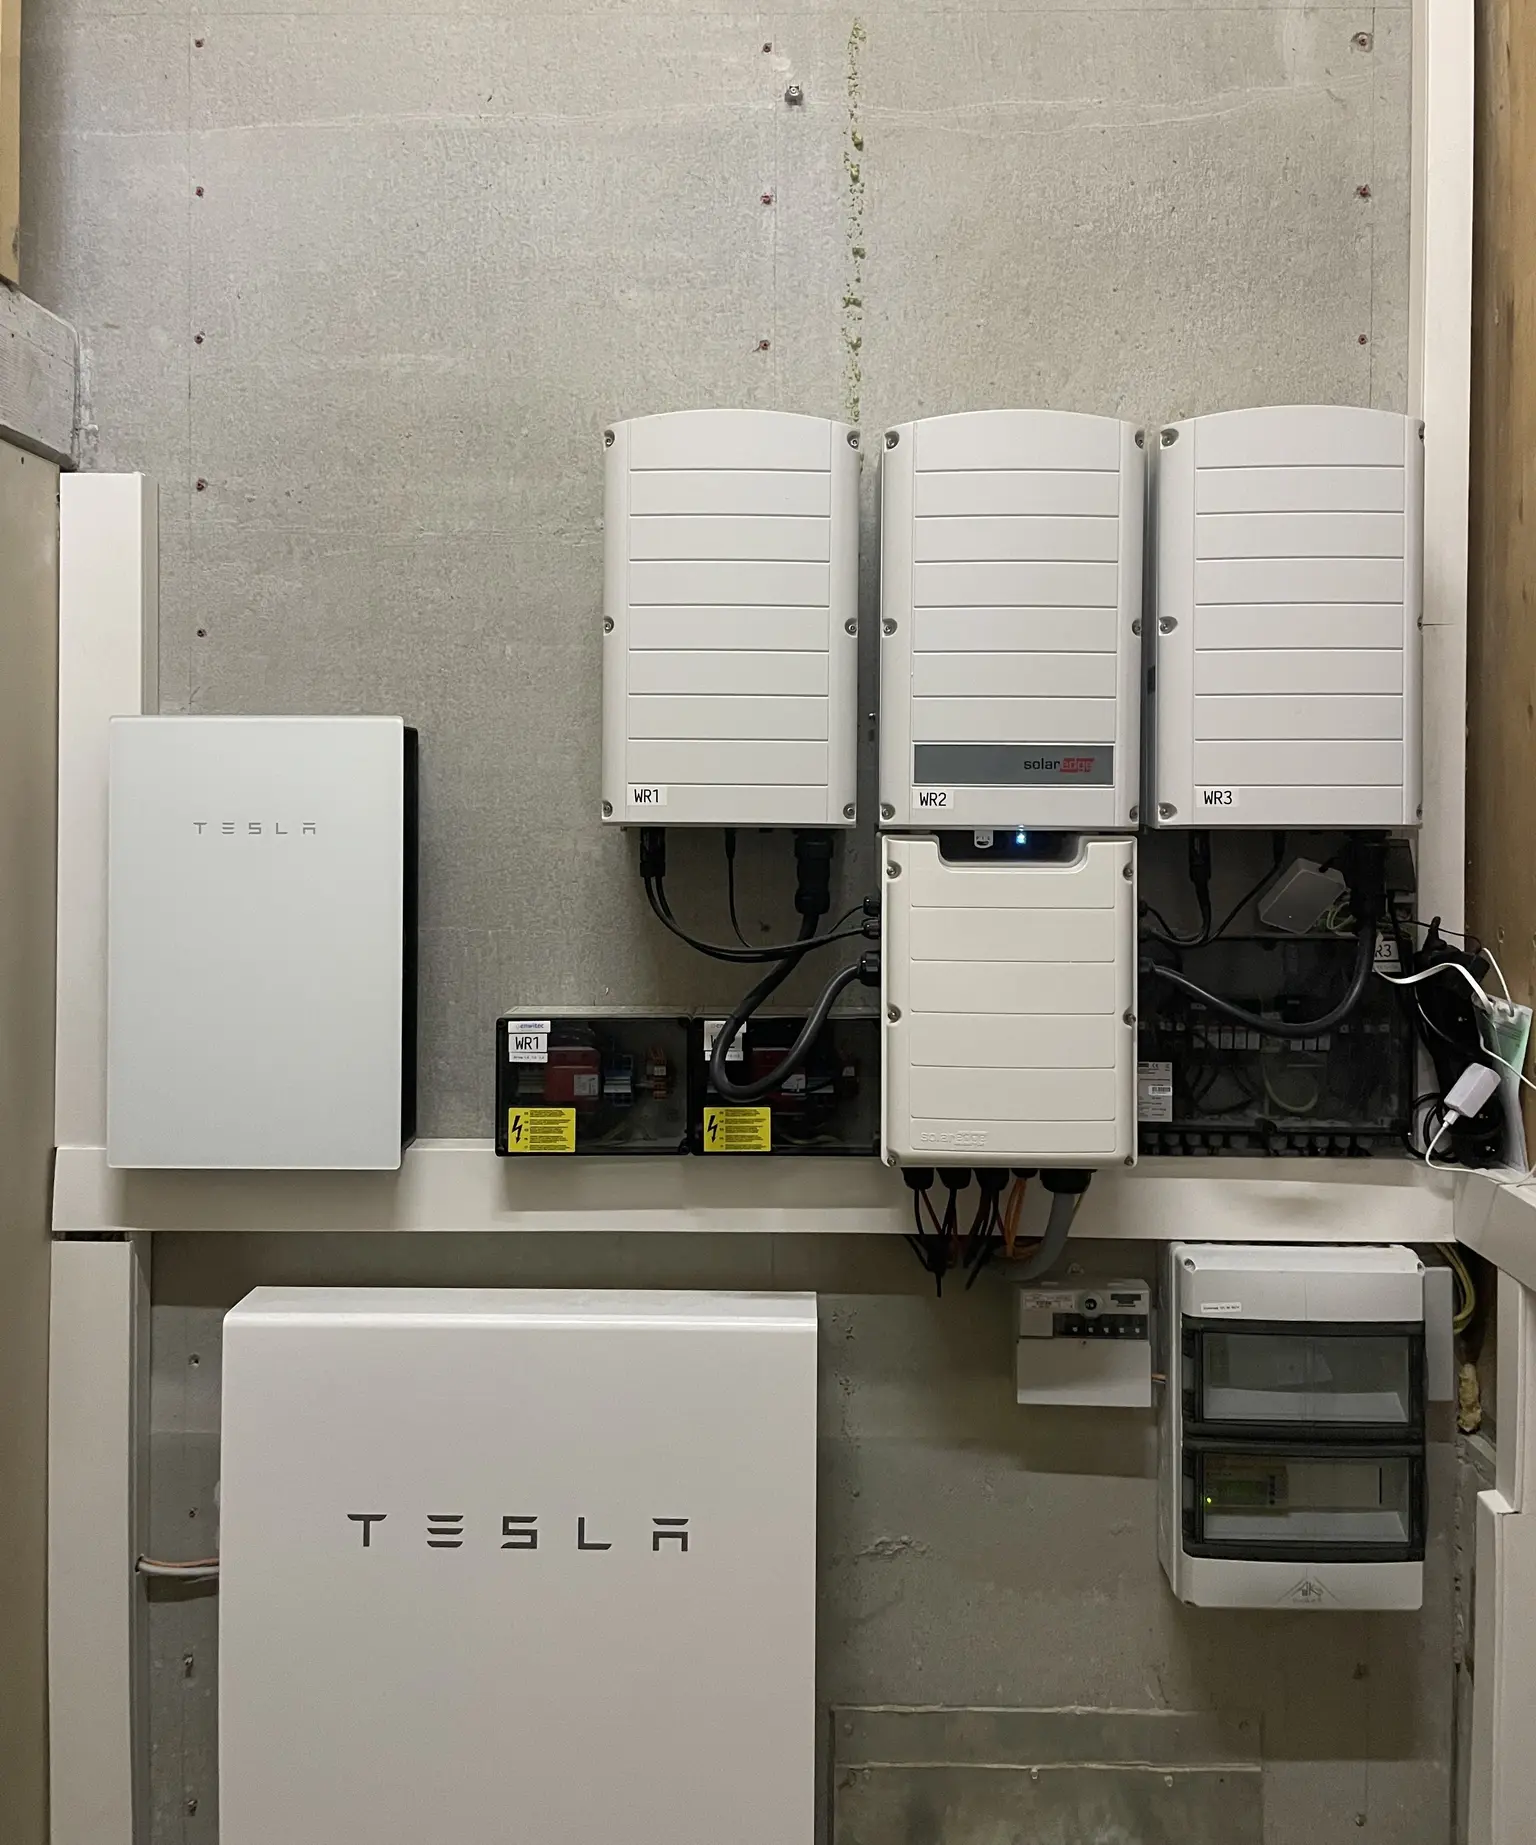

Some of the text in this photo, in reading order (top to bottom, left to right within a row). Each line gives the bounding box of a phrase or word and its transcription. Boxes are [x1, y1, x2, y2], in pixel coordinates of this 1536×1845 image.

[1023, 757, 1095, 773] solaredge
[634, 788, 659, 803] WR1
[919, 791, 947, 807] WR2
[1203, 790, 1233, 805] WR3
[193, 822, 316, 835] TESLA
[1375, 944, 1392, 958] R3
[515, 1036, 539, 1050] WR1
[347, 1513, 689, 1552] TESLA
